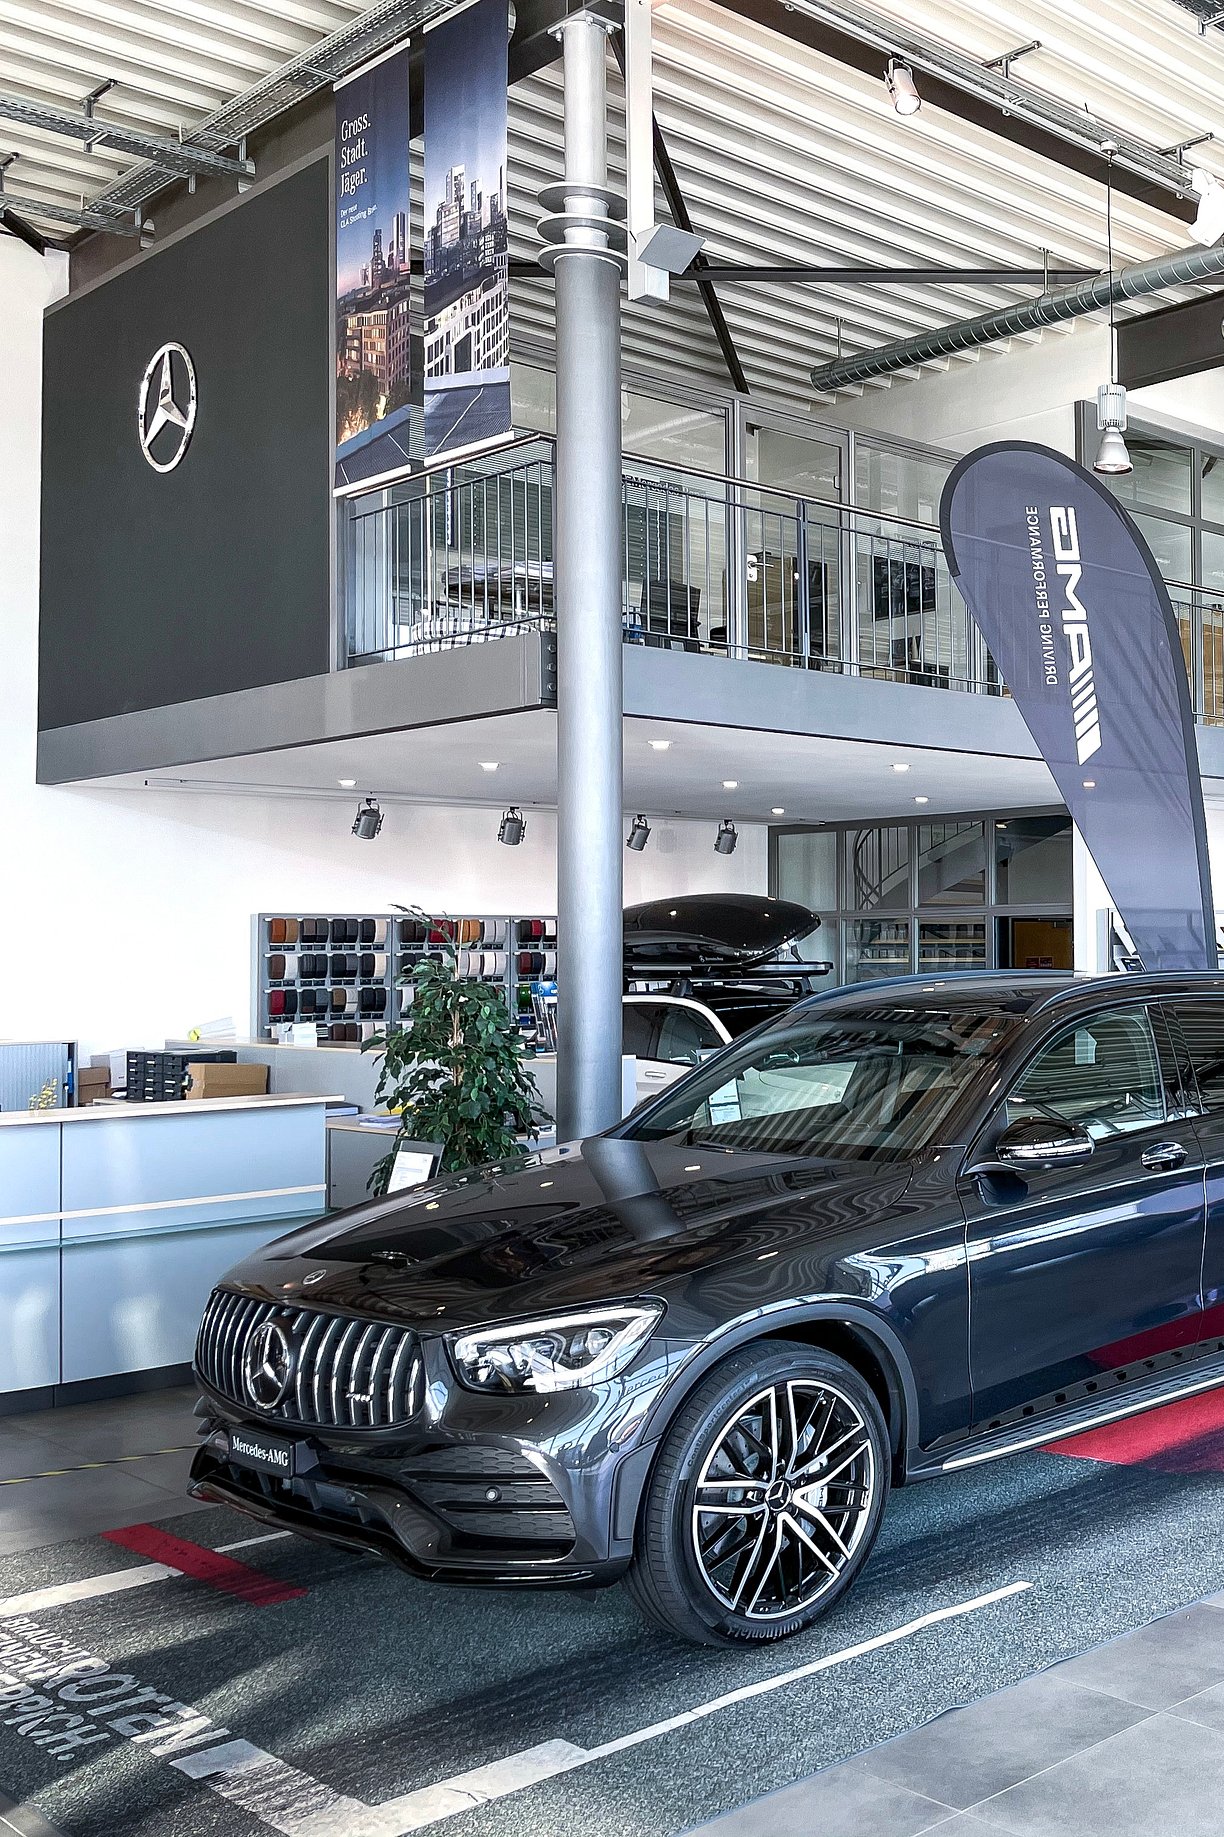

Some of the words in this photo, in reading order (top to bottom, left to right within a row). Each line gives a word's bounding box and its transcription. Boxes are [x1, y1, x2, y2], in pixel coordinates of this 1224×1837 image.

[341, 113, 371, 141] Gross.
[341, 137, 368, 168] Stadt.
[341, 167, 368, 197] Jäger.
[232, 1435, 289, 1467] Mercedes-AMG
[25, 1656, 232, 1757] ROTEN
